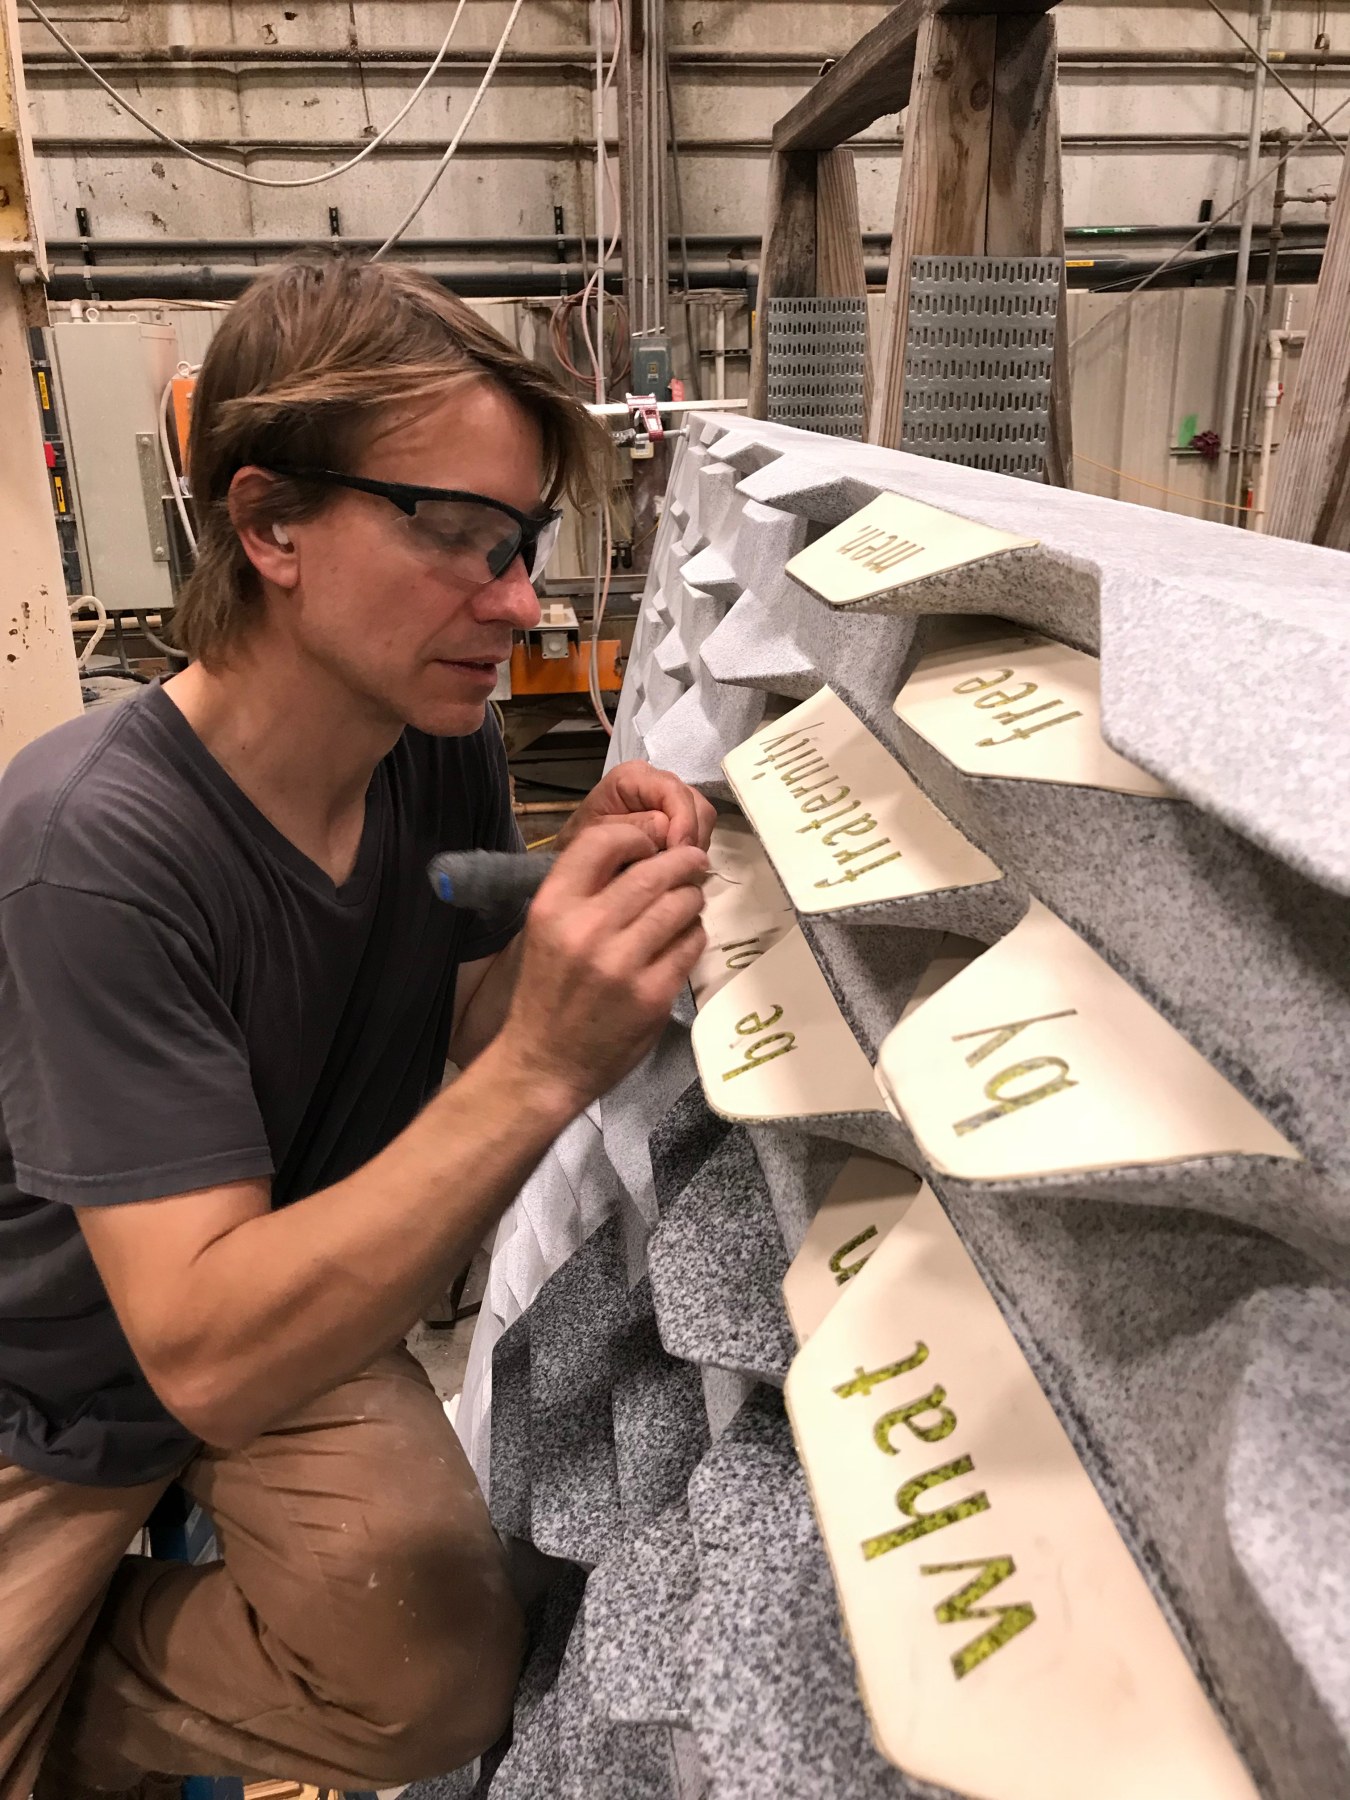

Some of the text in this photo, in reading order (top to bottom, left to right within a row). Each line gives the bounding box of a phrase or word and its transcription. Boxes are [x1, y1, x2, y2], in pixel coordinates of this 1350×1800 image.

[952, 668, 1083, 747] free
[751, 721, 902, 888] fraternity
[721, 1003, 798, 1082] be
[951, 1008, 1079, 1137] by
[832, 1340, 1037, 1680] What
